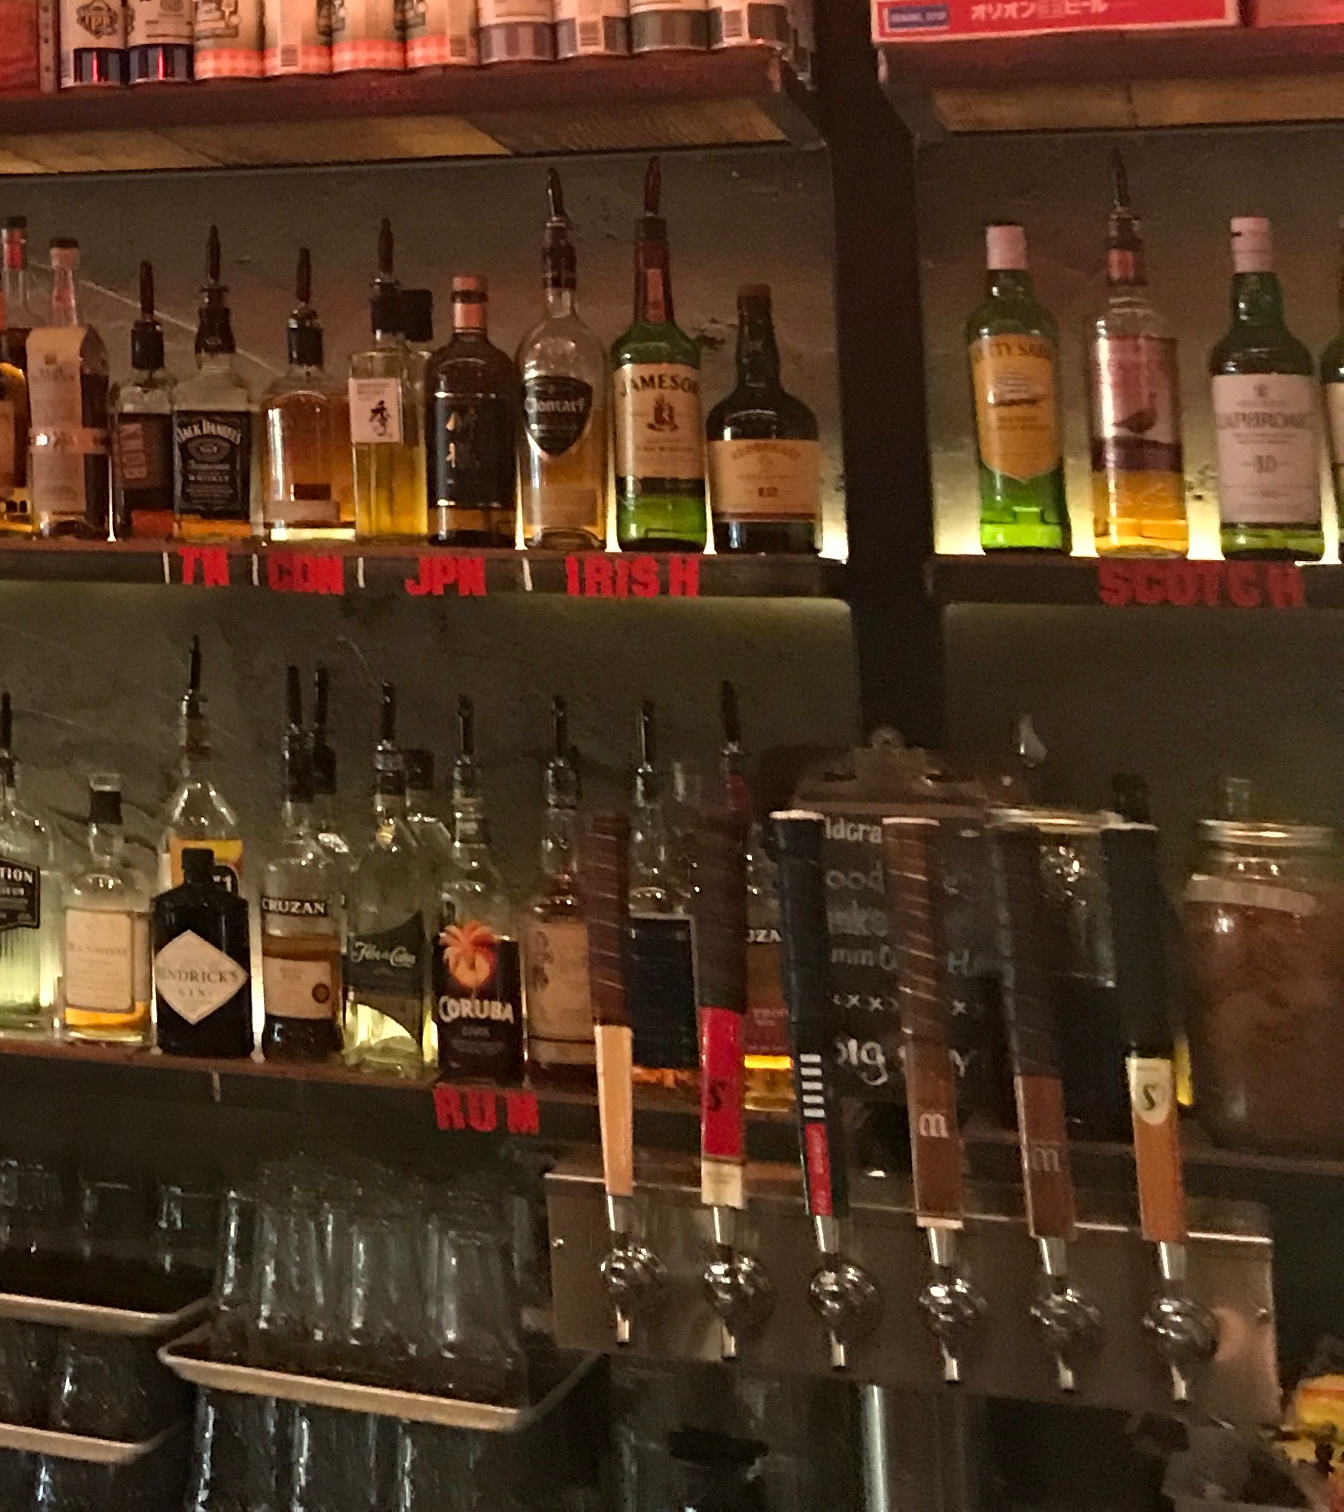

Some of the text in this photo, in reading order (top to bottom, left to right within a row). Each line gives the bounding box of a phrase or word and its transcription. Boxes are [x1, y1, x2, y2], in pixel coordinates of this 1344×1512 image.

[178, 545, 230, 587] TN
[404, 555, 486, 597] JPN
[564, 553, 701, 599] IRISH
[1098, 559, 1306, 609] SCOTCH
[262, 898, 327, 916] CRUZAN
[438, 995, 515, 1024] CORUBA
[433, 1082, 540, 1136] RUM
